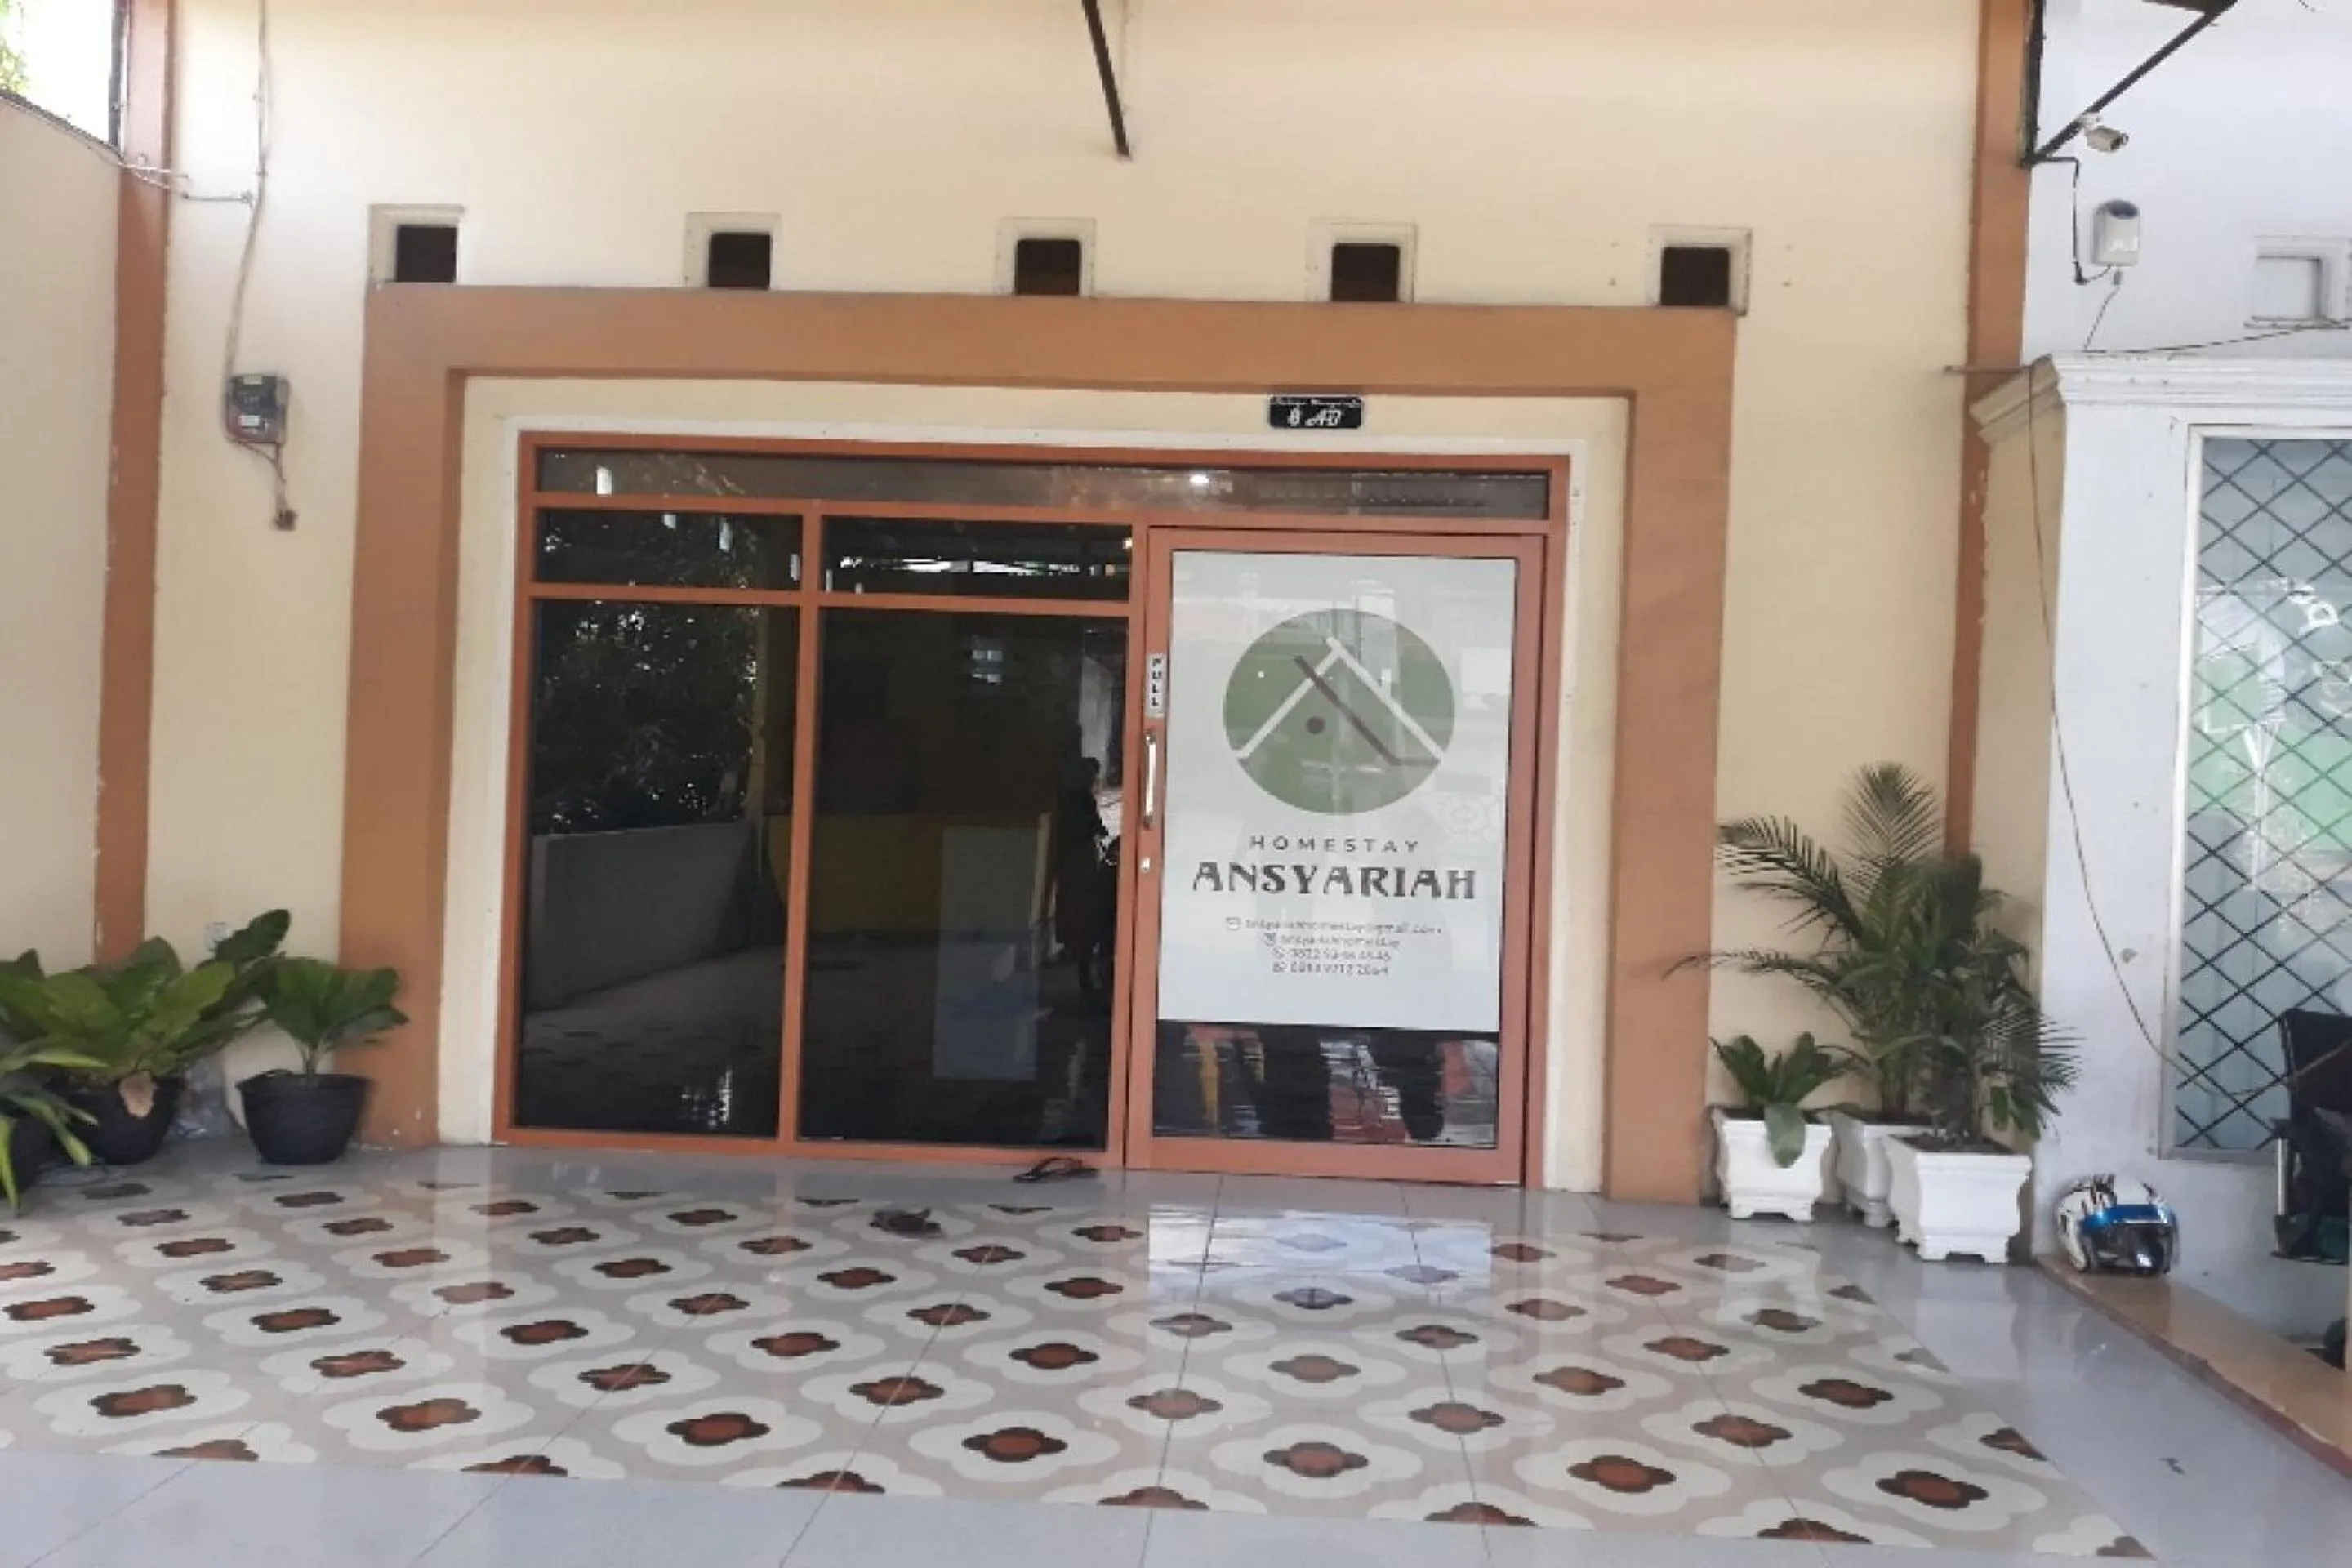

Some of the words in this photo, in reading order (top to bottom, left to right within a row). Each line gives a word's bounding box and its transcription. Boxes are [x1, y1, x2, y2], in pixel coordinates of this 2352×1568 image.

[1152, 658, 1162, 706] PULL
[1250, 835, 1419, 853] HOMESTAY
[1192, 862, 1476, 899] ANSYARIAH
